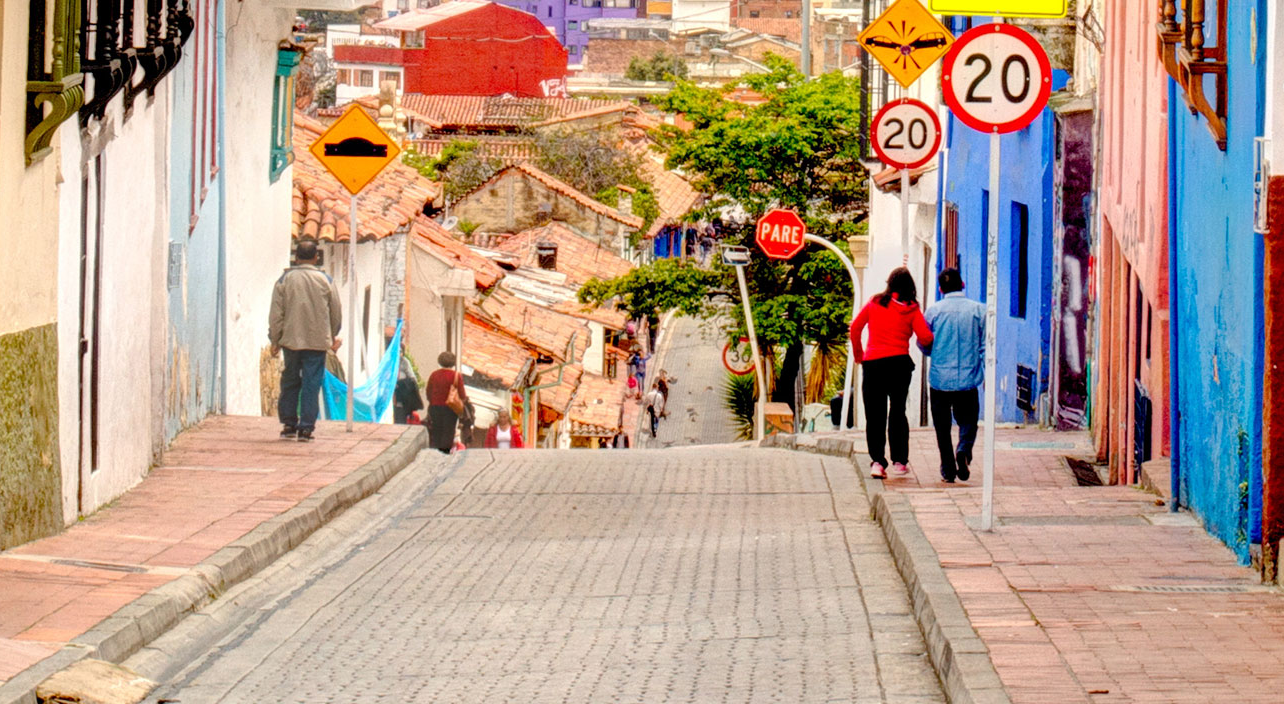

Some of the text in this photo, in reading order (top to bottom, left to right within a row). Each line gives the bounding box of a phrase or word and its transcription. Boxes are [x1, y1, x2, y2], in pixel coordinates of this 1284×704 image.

[964, 53, 1030, 103] 20
[883, 118, 927, 149] 20
[761, 222, 801, 244] PARE
